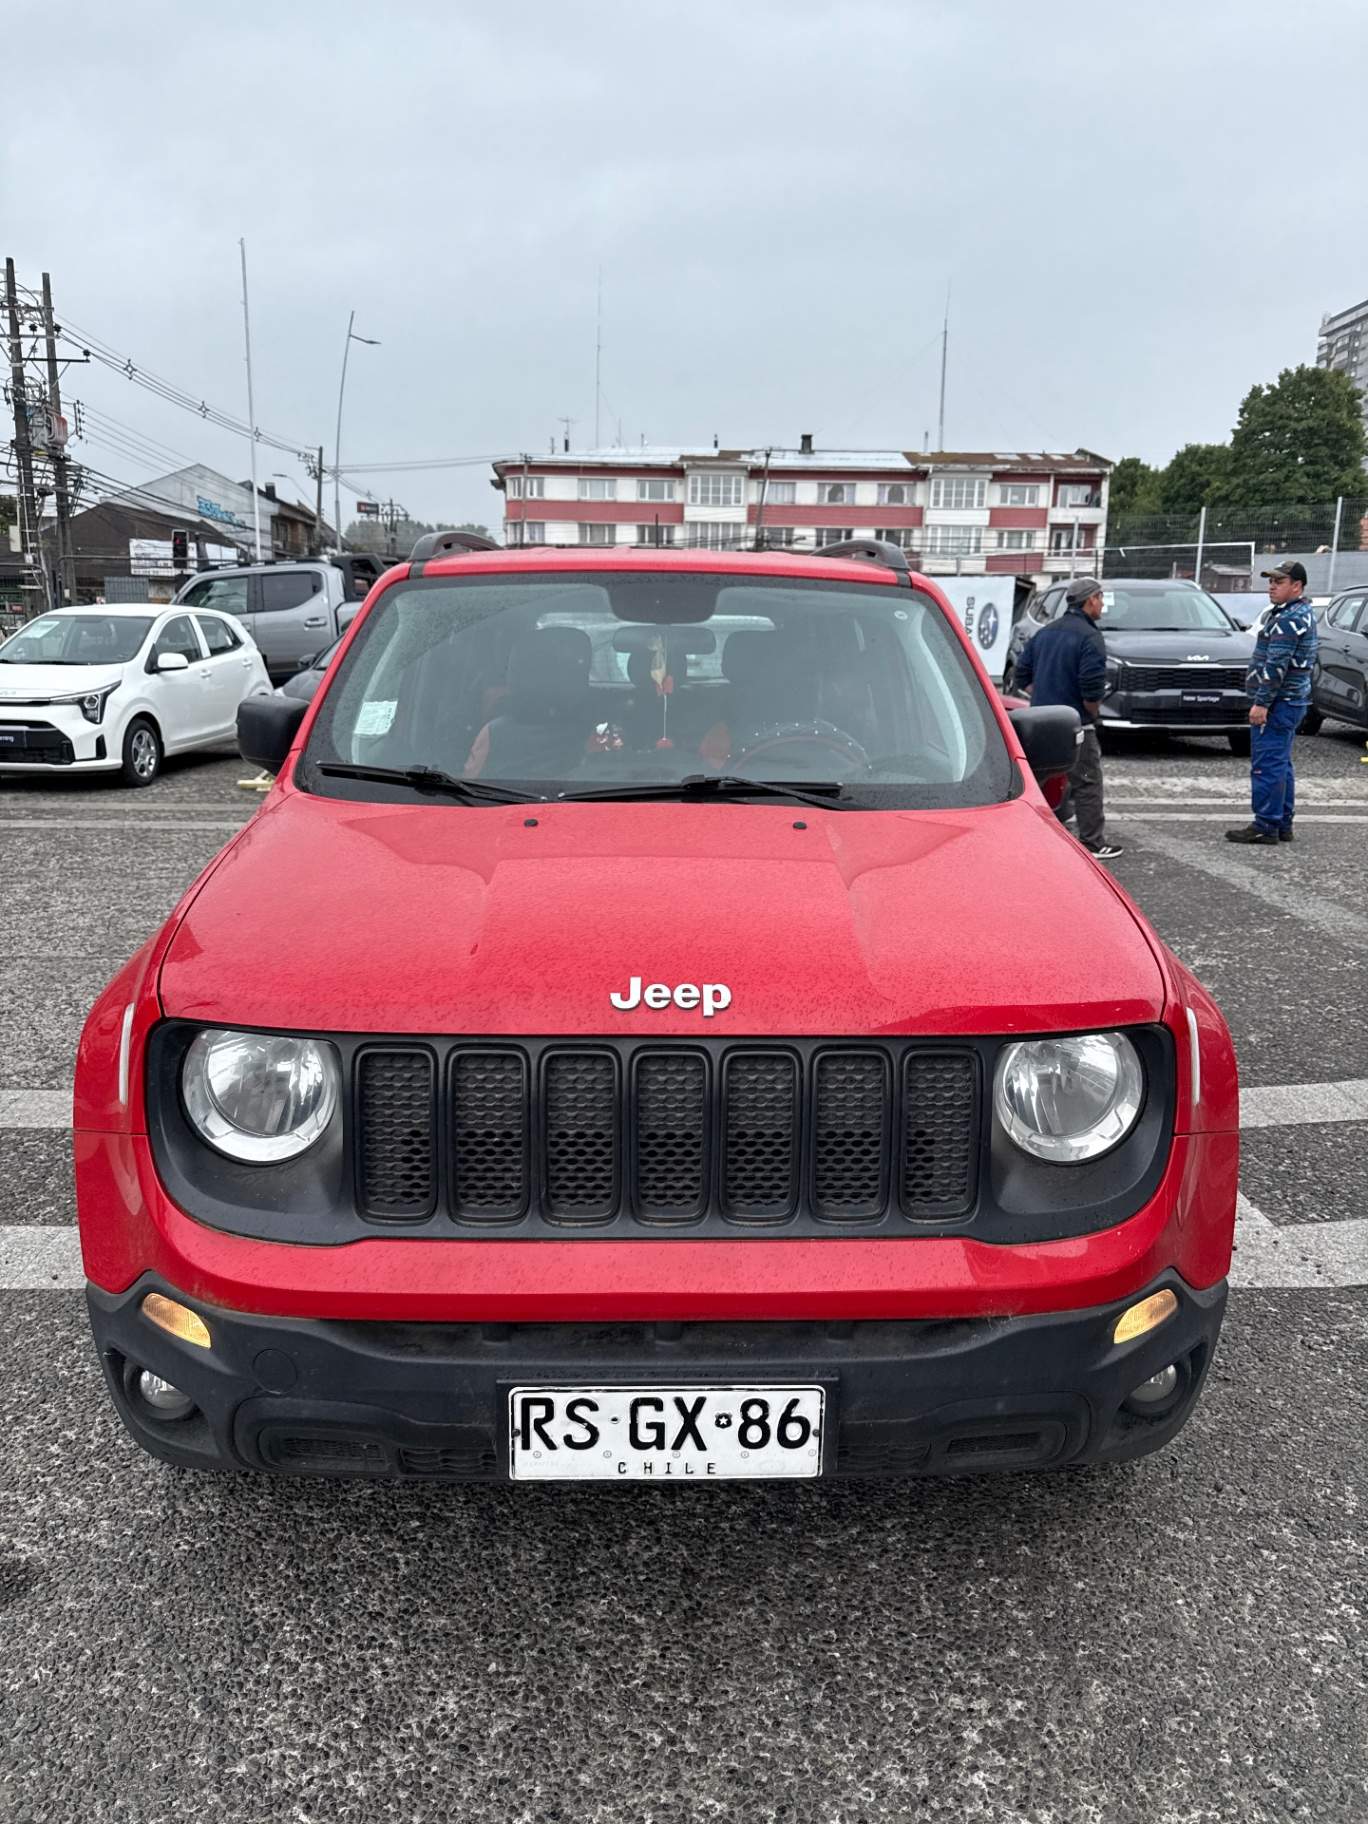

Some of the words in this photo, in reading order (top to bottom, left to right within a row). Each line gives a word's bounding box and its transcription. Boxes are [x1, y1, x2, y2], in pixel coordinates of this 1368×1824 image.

[964, 596, 976, 640] SUBA
[609, 976, 732, 1018] Jeep
[521, 1397, 600, 1451] RS
[628, 1396, 708, 1451] GX
[737, 1398, 812, 1450] 86
[617, 1462, 717, 1475] CHILE
